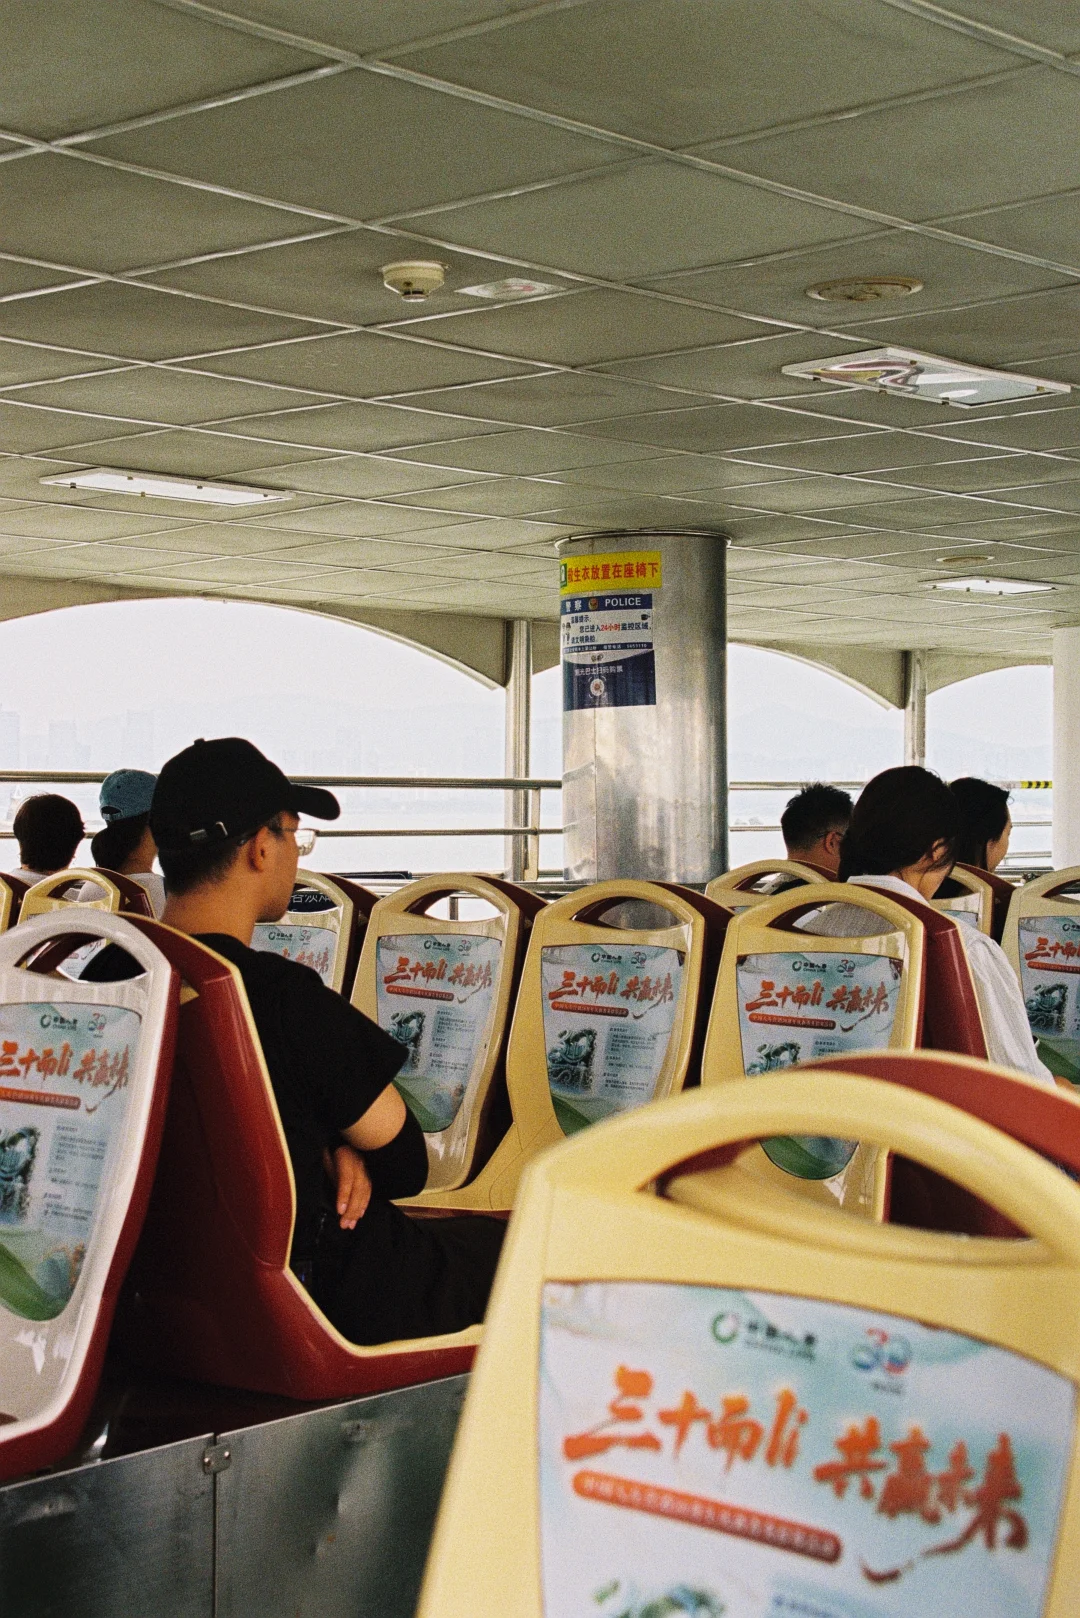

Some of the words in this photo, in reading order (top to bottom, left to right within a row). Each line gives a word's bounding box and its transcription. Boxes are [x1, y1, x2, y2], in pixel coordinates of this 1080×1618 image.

[568, 562, 659, 583] 救生衣放置在座椅下
[565, 600, 582, 612] 警察
[605, 597, 642, 607] POLICE
[1024, 936, 1080, 961] 三十而
[813, 1415, 1028, 1566] 共赢未来
